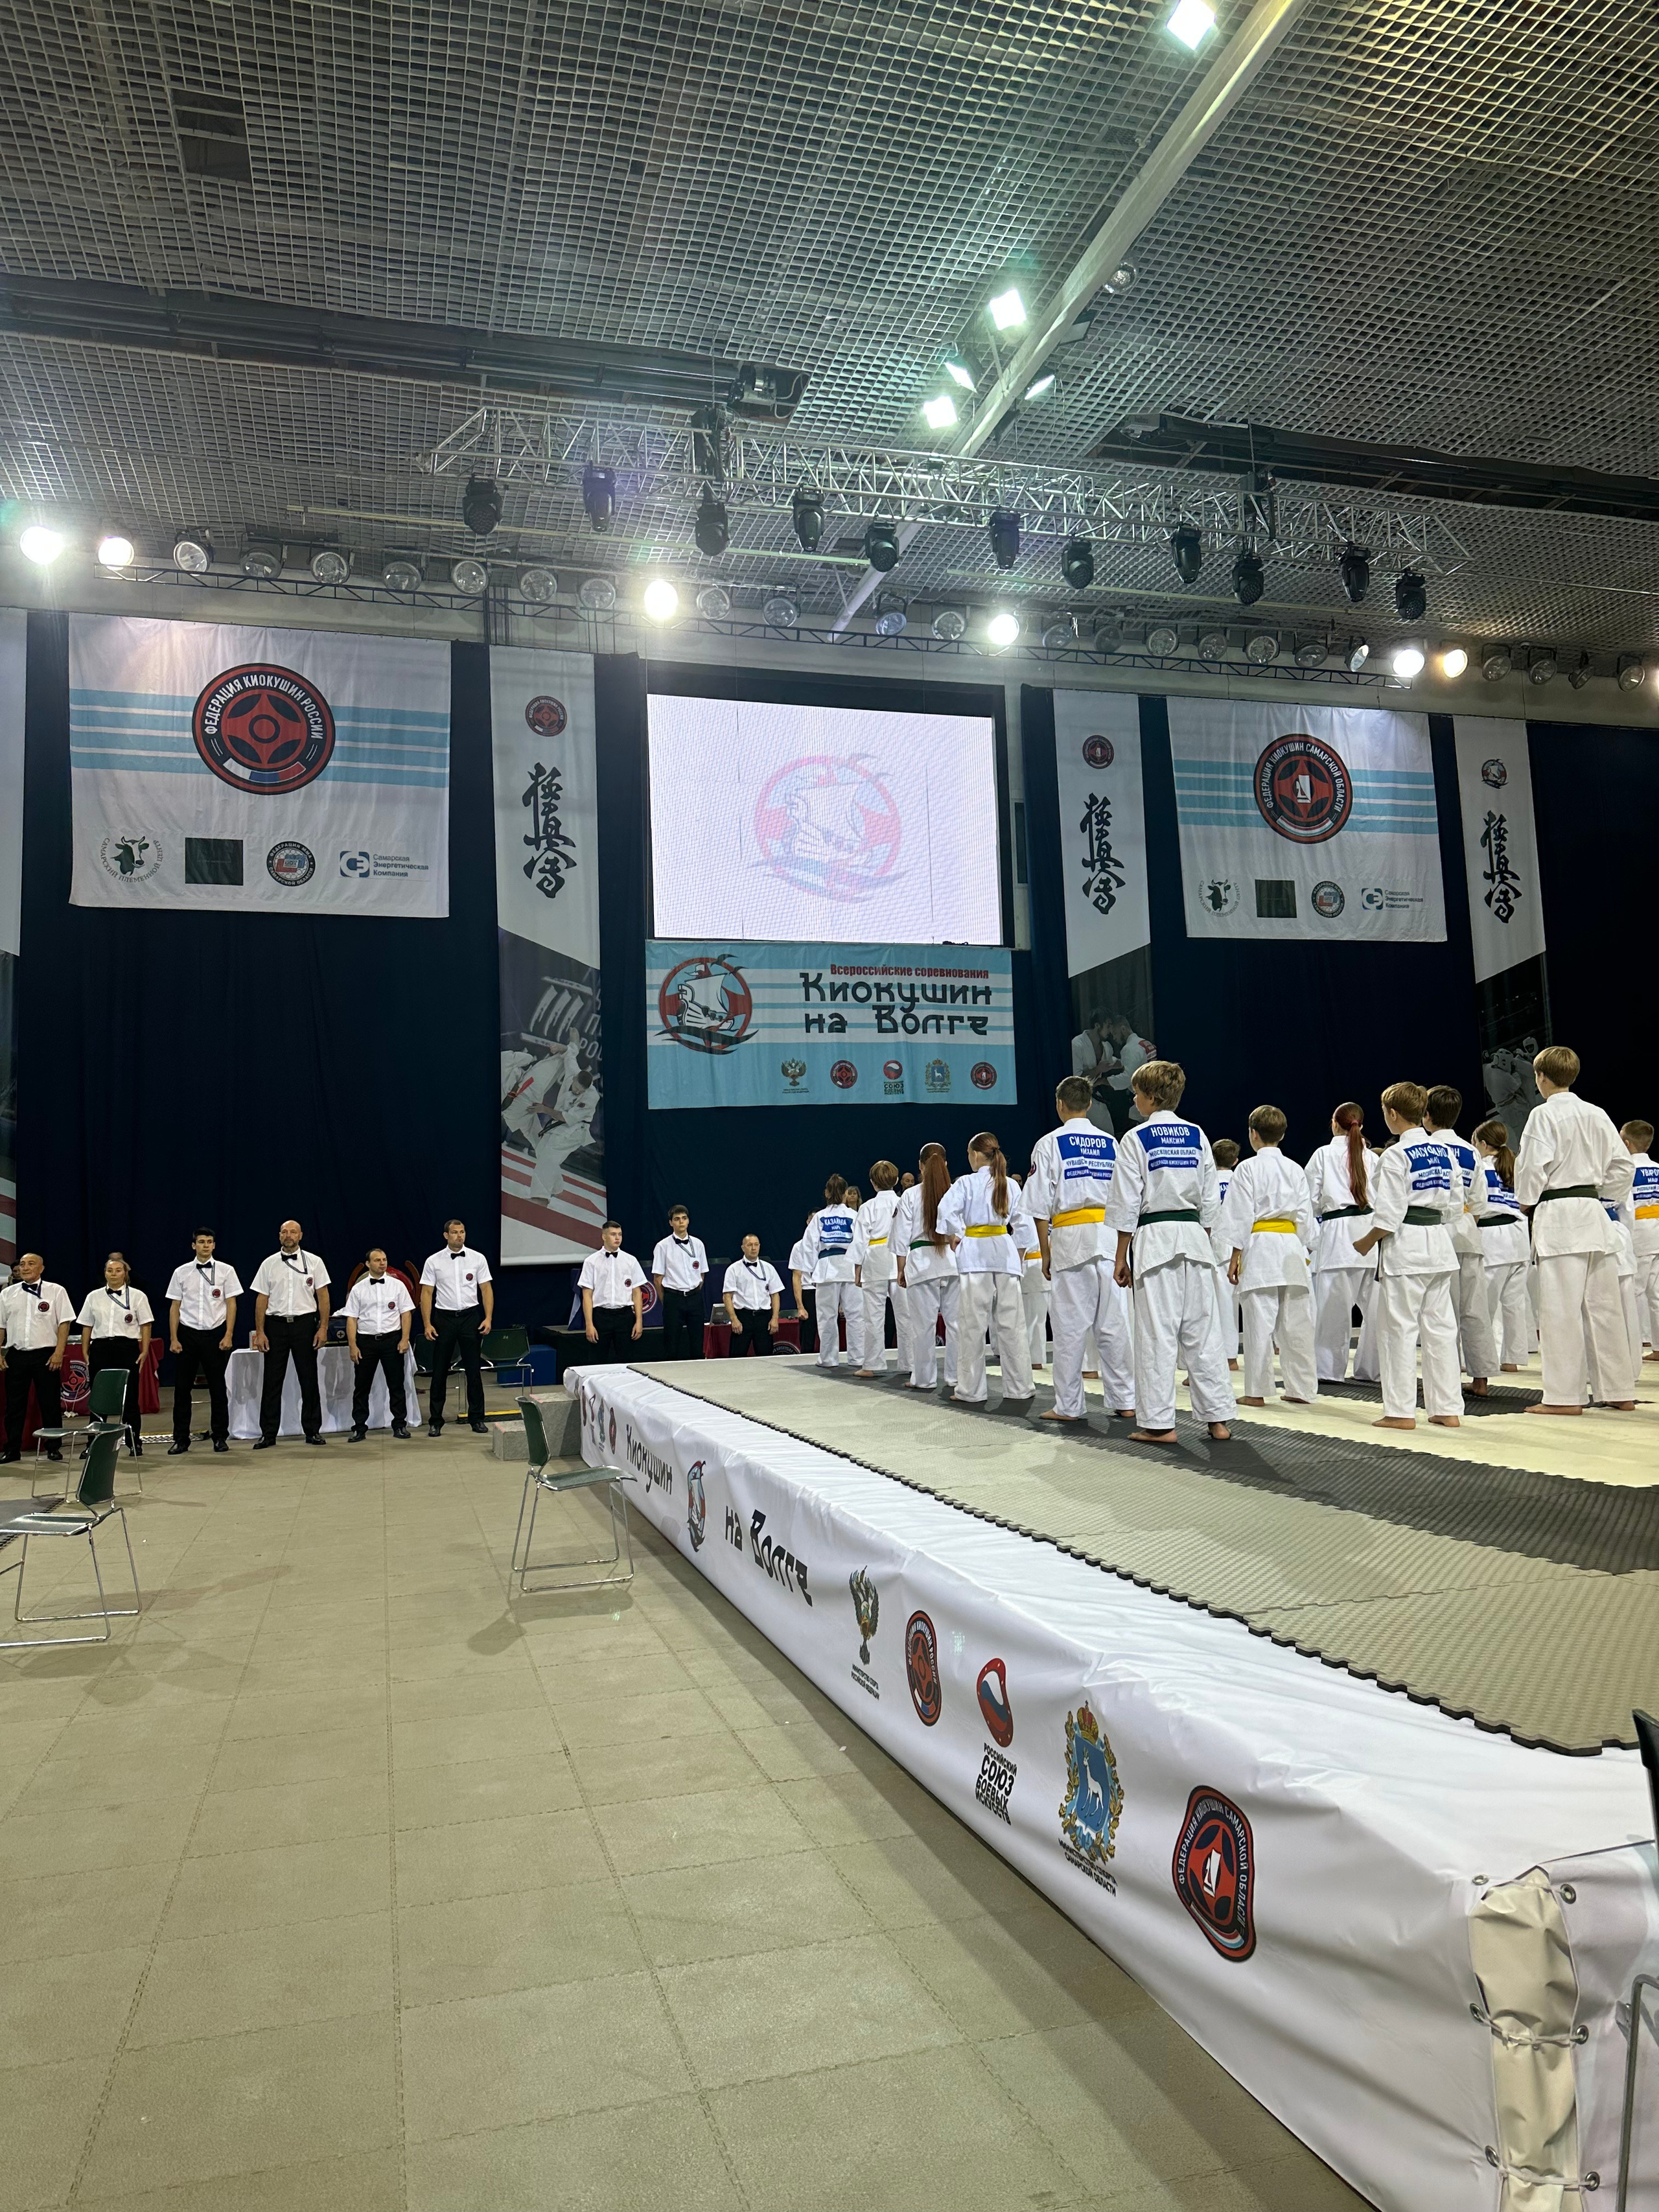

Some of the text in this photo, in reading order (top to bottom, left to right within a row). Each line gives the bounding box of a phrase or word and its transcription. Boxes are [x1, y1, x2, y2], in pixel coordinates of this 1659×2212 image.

[204, 674, 323, 739] ФЕДЕРАЦИЯ КИОКУШИН РОССИИ
[1261, 742, 1345, 813] ФЕДЕРАЦИЯ КИОКУШИН САМАРСКОЙ ОБЛАСТИ
[100, 837, 119, 878] САМАРСКИЙ
[119, 863, 161, 883] ПЛЕМЕННОЙ
[270, 843, 301, 857] ФЕДЕРАЦИЯ
[373, 854, 410, 863] Самарская
[373, 861, 429, 871] Энергетическая
[373, 869, 408, 878] Компания
[830, 964, 989, 979] Всероссийские соревнования
[799, 973, 992, 1014] Киокушин
[805, 1005, 989, 1036] на Волге
[1069, 1136, 1107, 1148] СИДОРОВ
[1150, 1126, 1190, 1137] НОВИКОВ
[1149, 1149, 1179, 1158] МОСКОВСКАЯ
[626, 1423, 673, 1495] Киокушин
[725, 1505, 813, 1607] на Волге
[916, 1620, 933, 1647] КИОКУШИН
[929, 1647, 937, 1684] РОССИИ
[981, 1754, 1015, 1797] СОЮЗ
[984, 1742, 1017, 1777] РОССИЙСКИЙ
[975, 1786, 1012, 1826] ИСКУССТВ
[976, 1773, 1009, 1814] БОЕВЫХ
[1178, 1798, 1248, 1928] ФЕДЕРАЦИЯ КИОКУШИН САМАРСКОЙ ОБЛАСТИ
